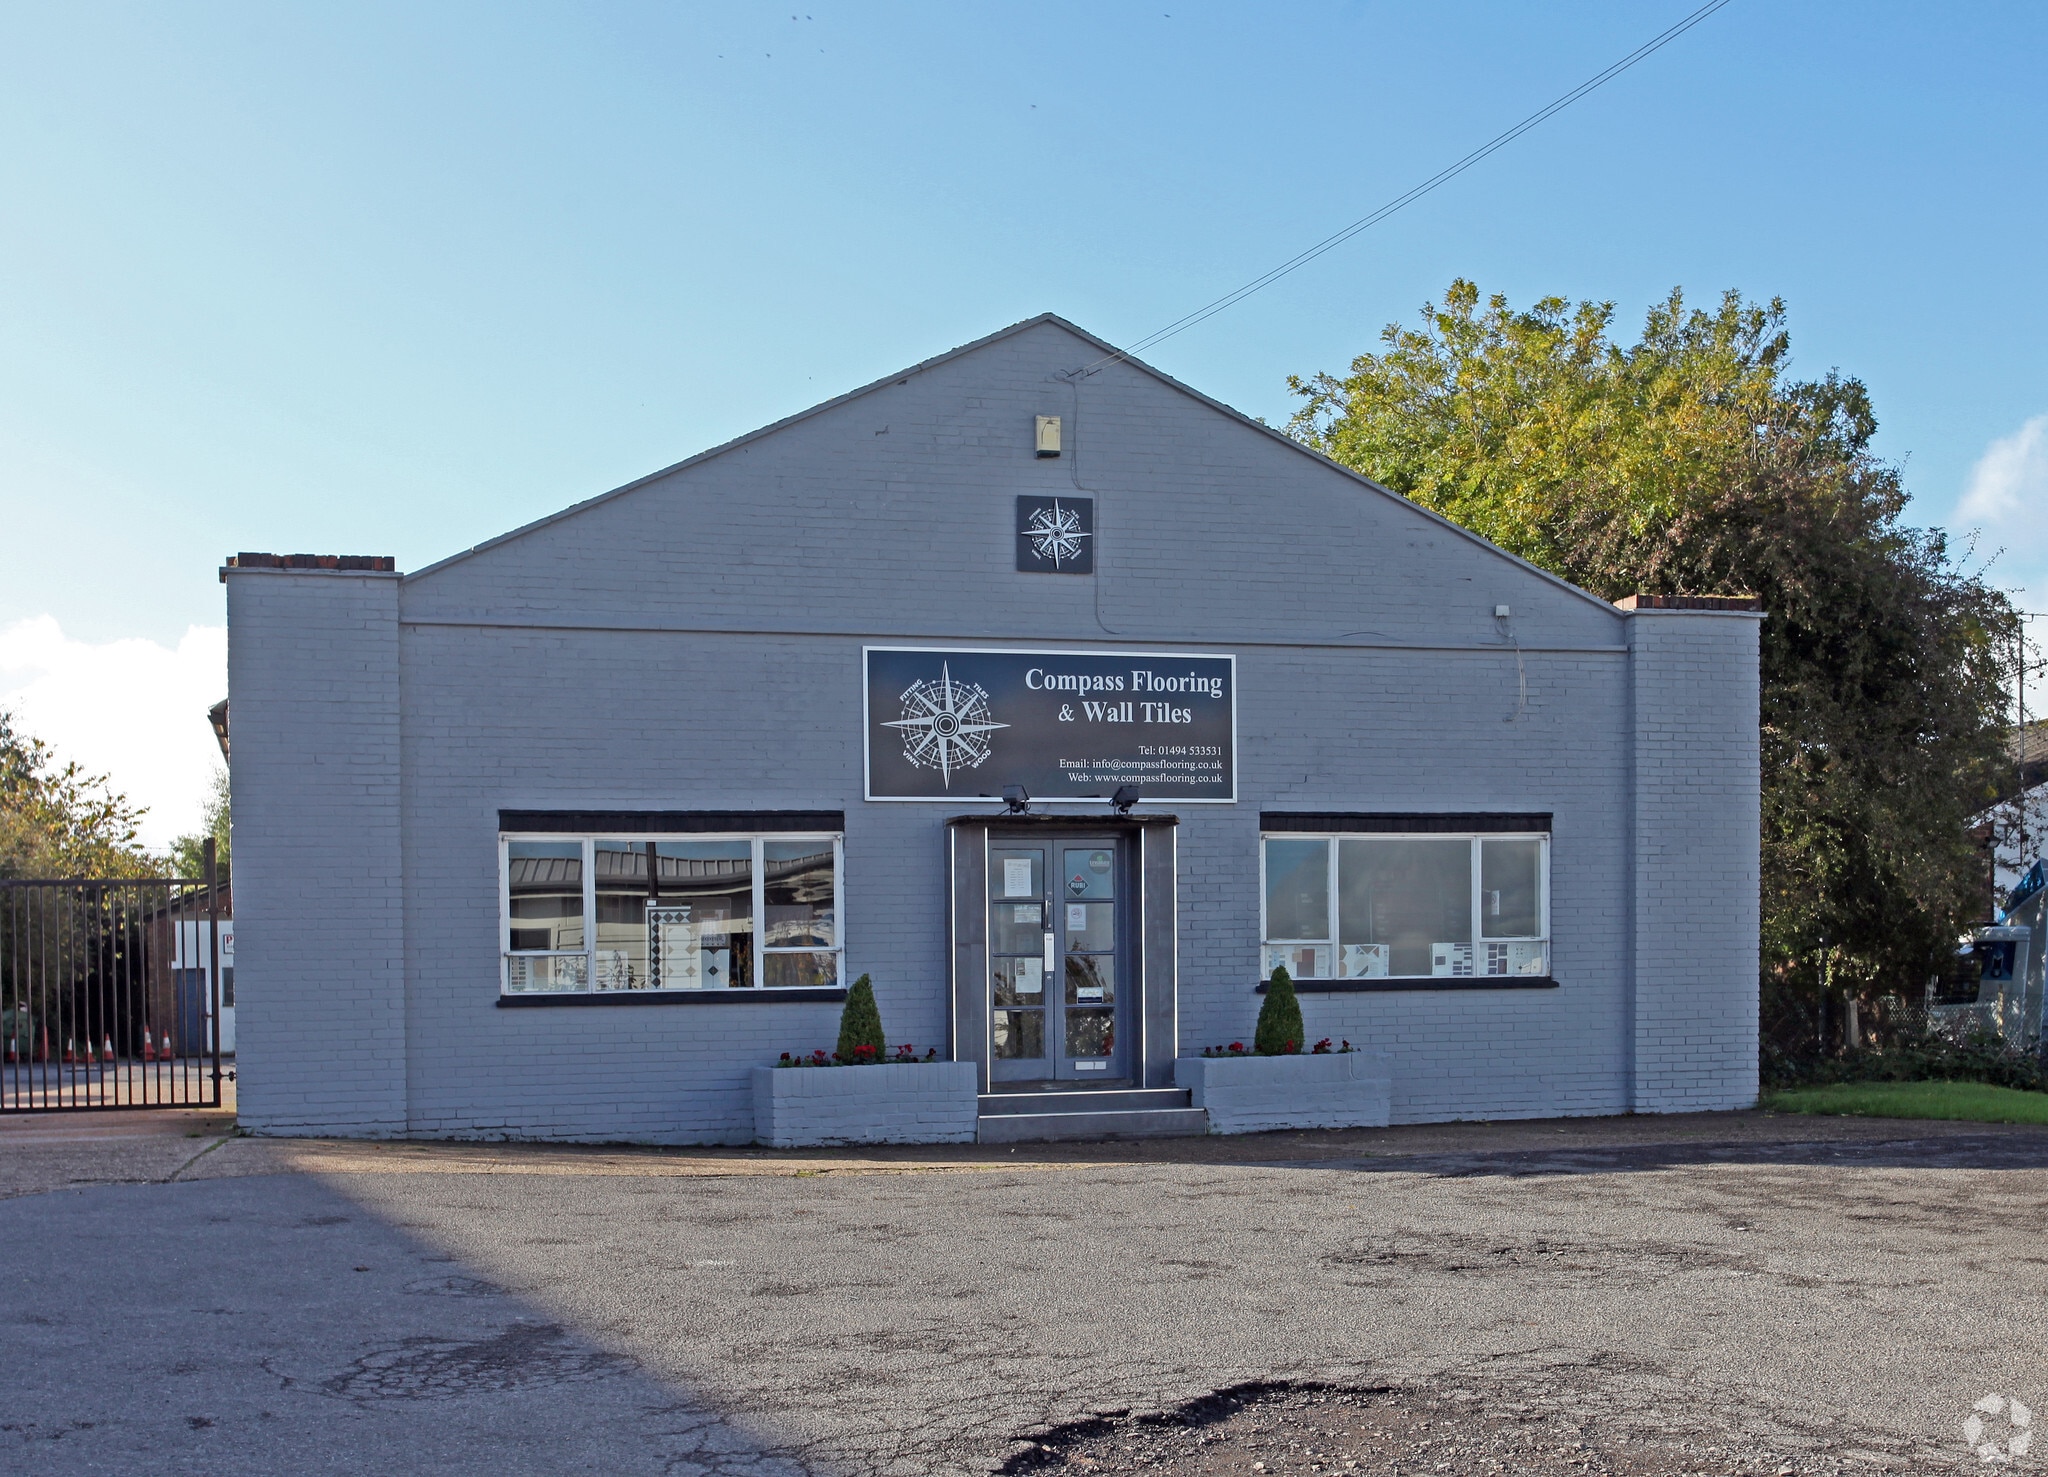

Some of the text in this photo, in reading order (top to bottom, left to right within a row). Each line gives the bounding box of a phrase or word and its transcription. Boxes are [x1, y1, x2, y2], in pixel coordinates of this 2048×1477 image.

[899, 678, 923, 702] FITTING
[973, 682, 990, 700] TILES
[1025, 668, 1223, 699] Compass Flooring
[1058, 701, 1192, 724] & Wall Tiles
[902, 750, 920, 769] VINYL
[971, 749, 992, 769] WOOD
[1138, 745, 1222, 756] Tel: 01494 533531
[1059, 758, 1223, 771] Email: info@compassflooring.co.uk
[1068, 772, 1223, 784] Web: www.compassflooring.co.uk
